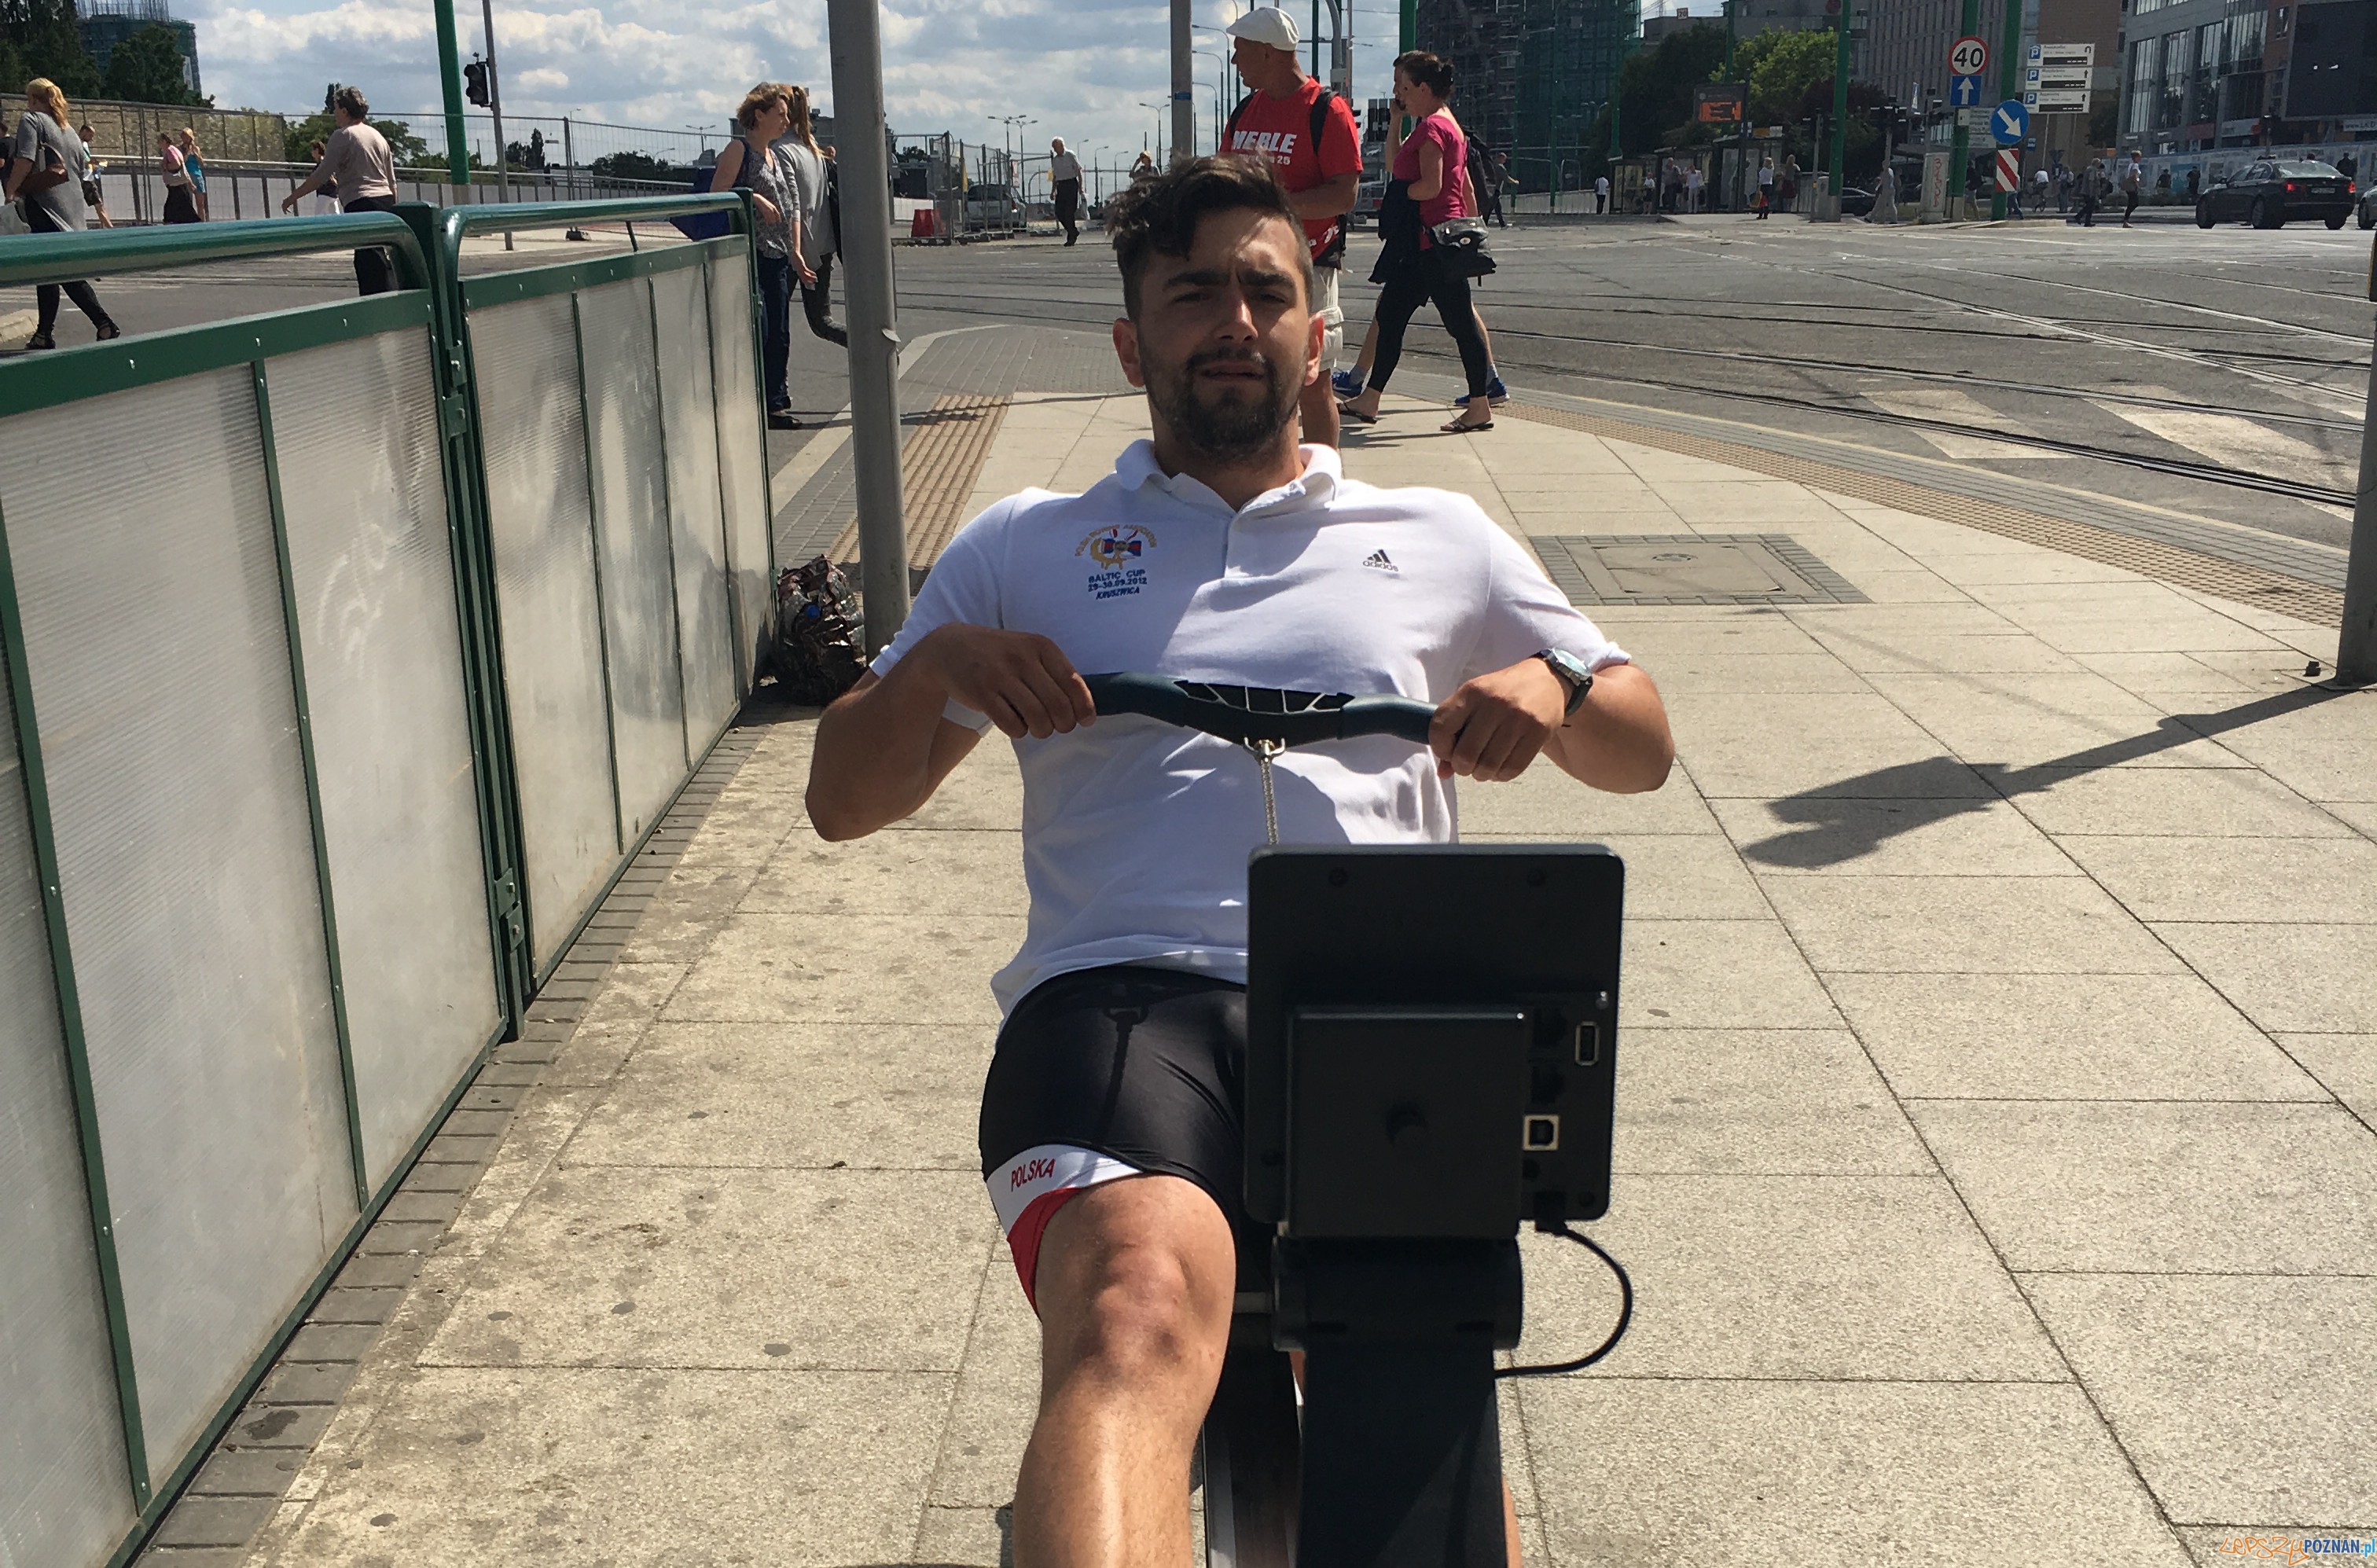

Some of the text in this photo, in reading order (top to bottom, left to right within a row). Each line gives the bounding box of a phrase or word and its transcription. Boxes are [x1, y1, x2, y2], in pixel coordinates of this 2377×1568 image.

[1953, 47, 1984, 68] 40
[2030, 48, 2038, 57] P
[2029, 70, 2037, 79] P
[2026, 94, 2034, 103] P
[1362, 560, 1399, 572] adidas
[1088, 568, 1146, 584] BALTIC CUP
[1096, 586, 1140, 600] KRUSZWICA
[1011, 1158, 1056, 1192] POLSKA
